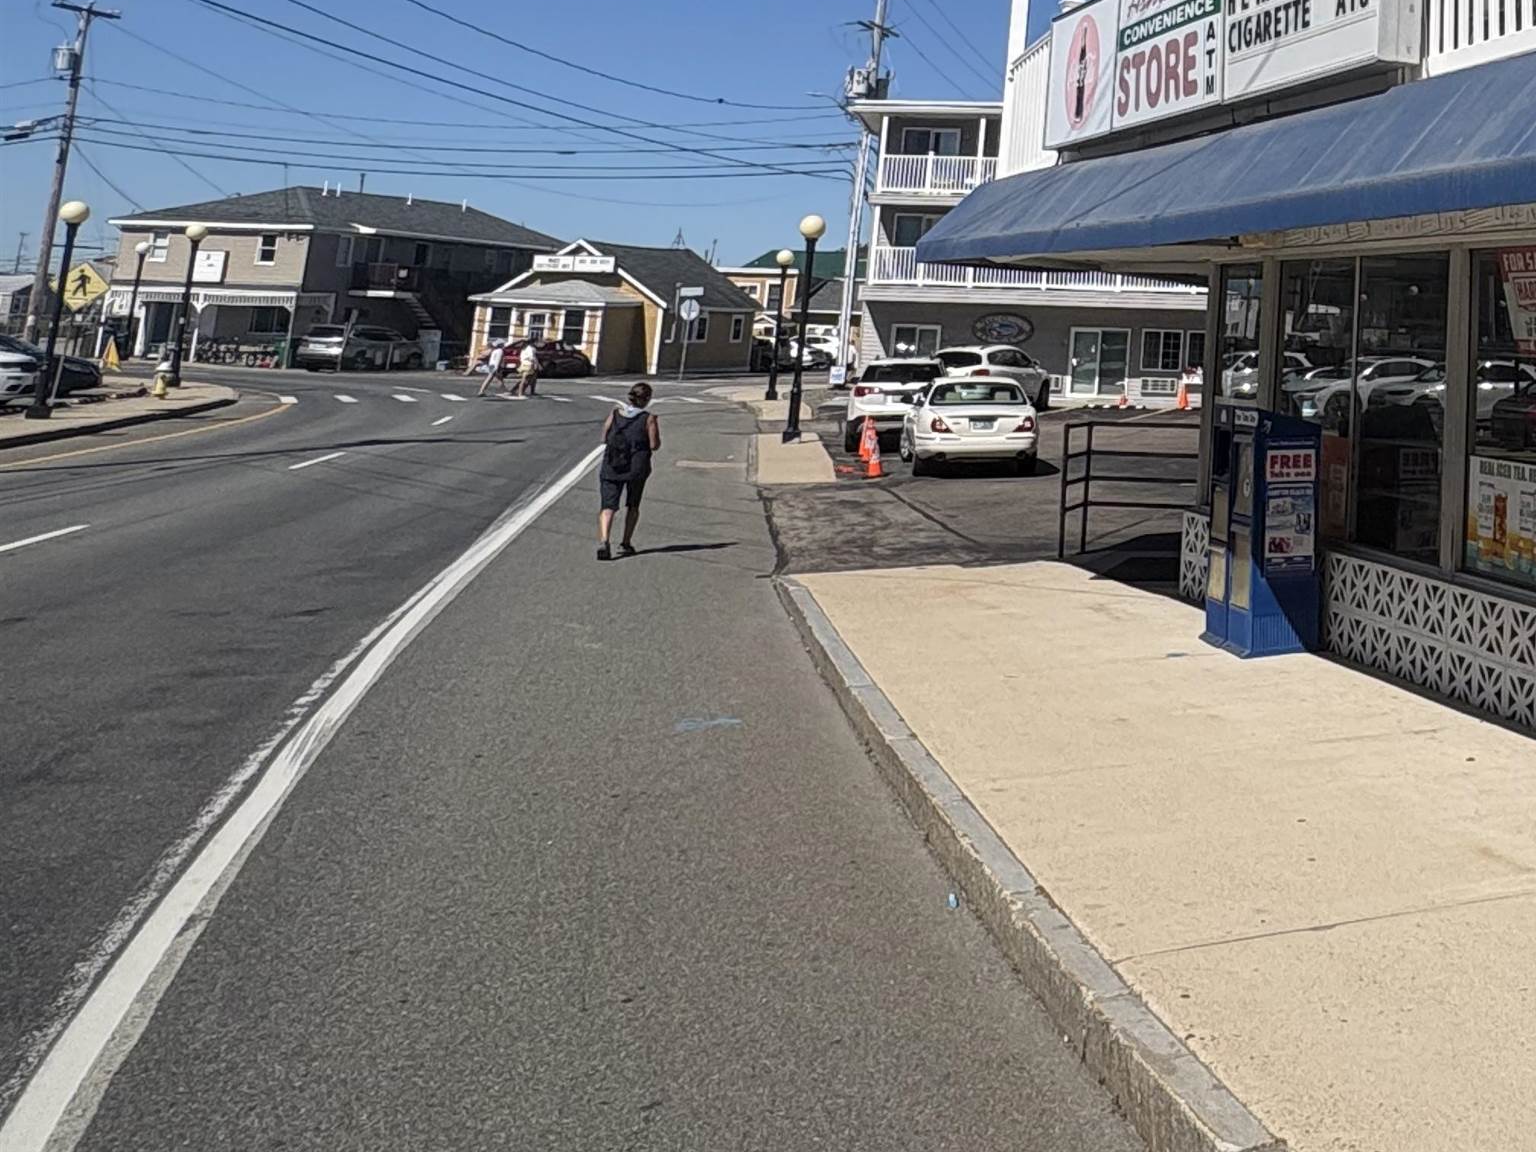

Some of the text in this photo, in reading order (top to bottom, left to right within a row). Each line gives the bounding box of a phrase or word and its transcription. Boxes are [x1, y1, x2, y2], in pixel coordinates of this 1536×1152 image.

[1117, 30, 1199, 117] STORE
[1206, 21, 1216, 95] ATM
[1503, 252, 1525, 271] FOR
[1269, 453, 1312, 469] FREE
